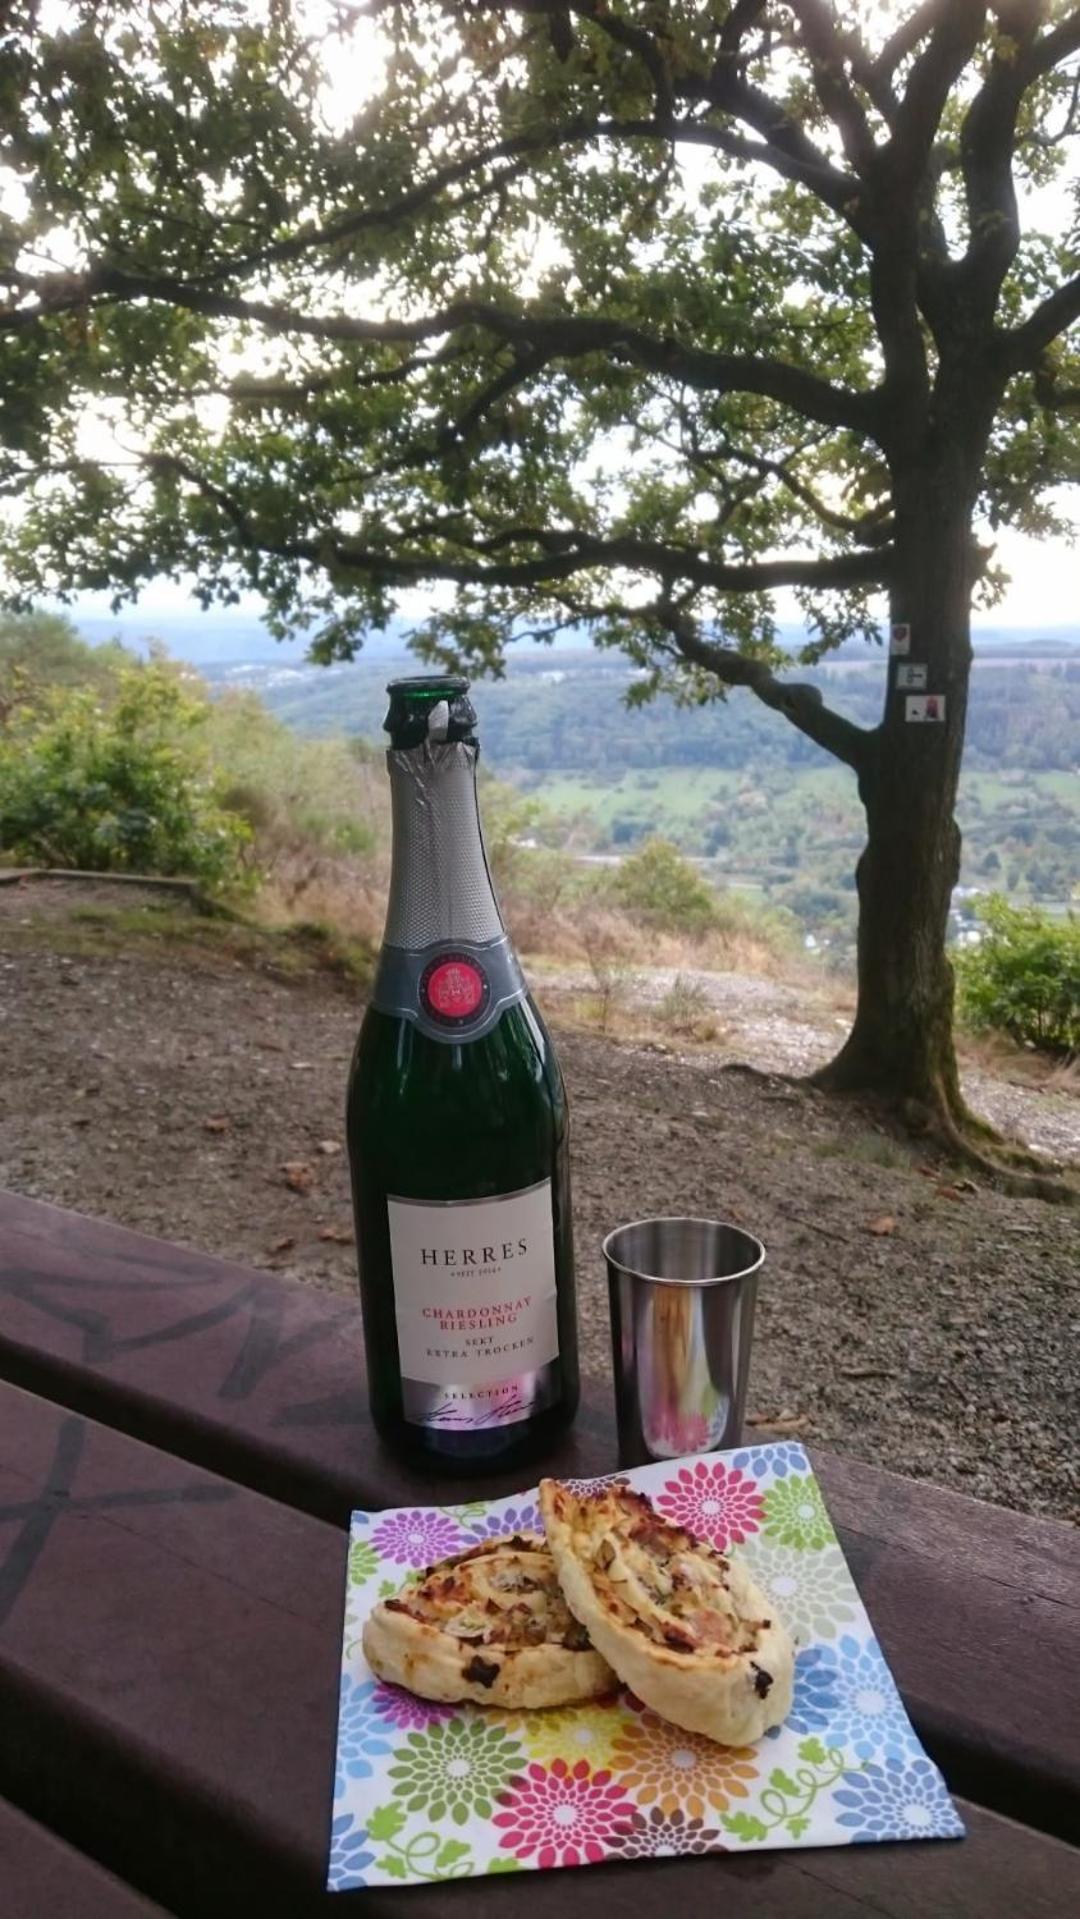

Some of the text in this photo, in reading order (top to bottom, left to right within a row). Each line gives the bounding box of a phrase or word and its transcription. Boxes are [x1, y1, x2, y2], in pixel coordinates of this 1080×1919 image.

[420, 1238, 528, 1266] HERRES
[422, 1296, 532, 1320] CHARDONNAY
[440, 1313, 517, 1330] RIESLING
[427, 1337, 534, 1358] EXTRA TROCKEN
[465, 1336, 493, 1346] SEKT
[444, 1385, 518, 1399] SELECTION
